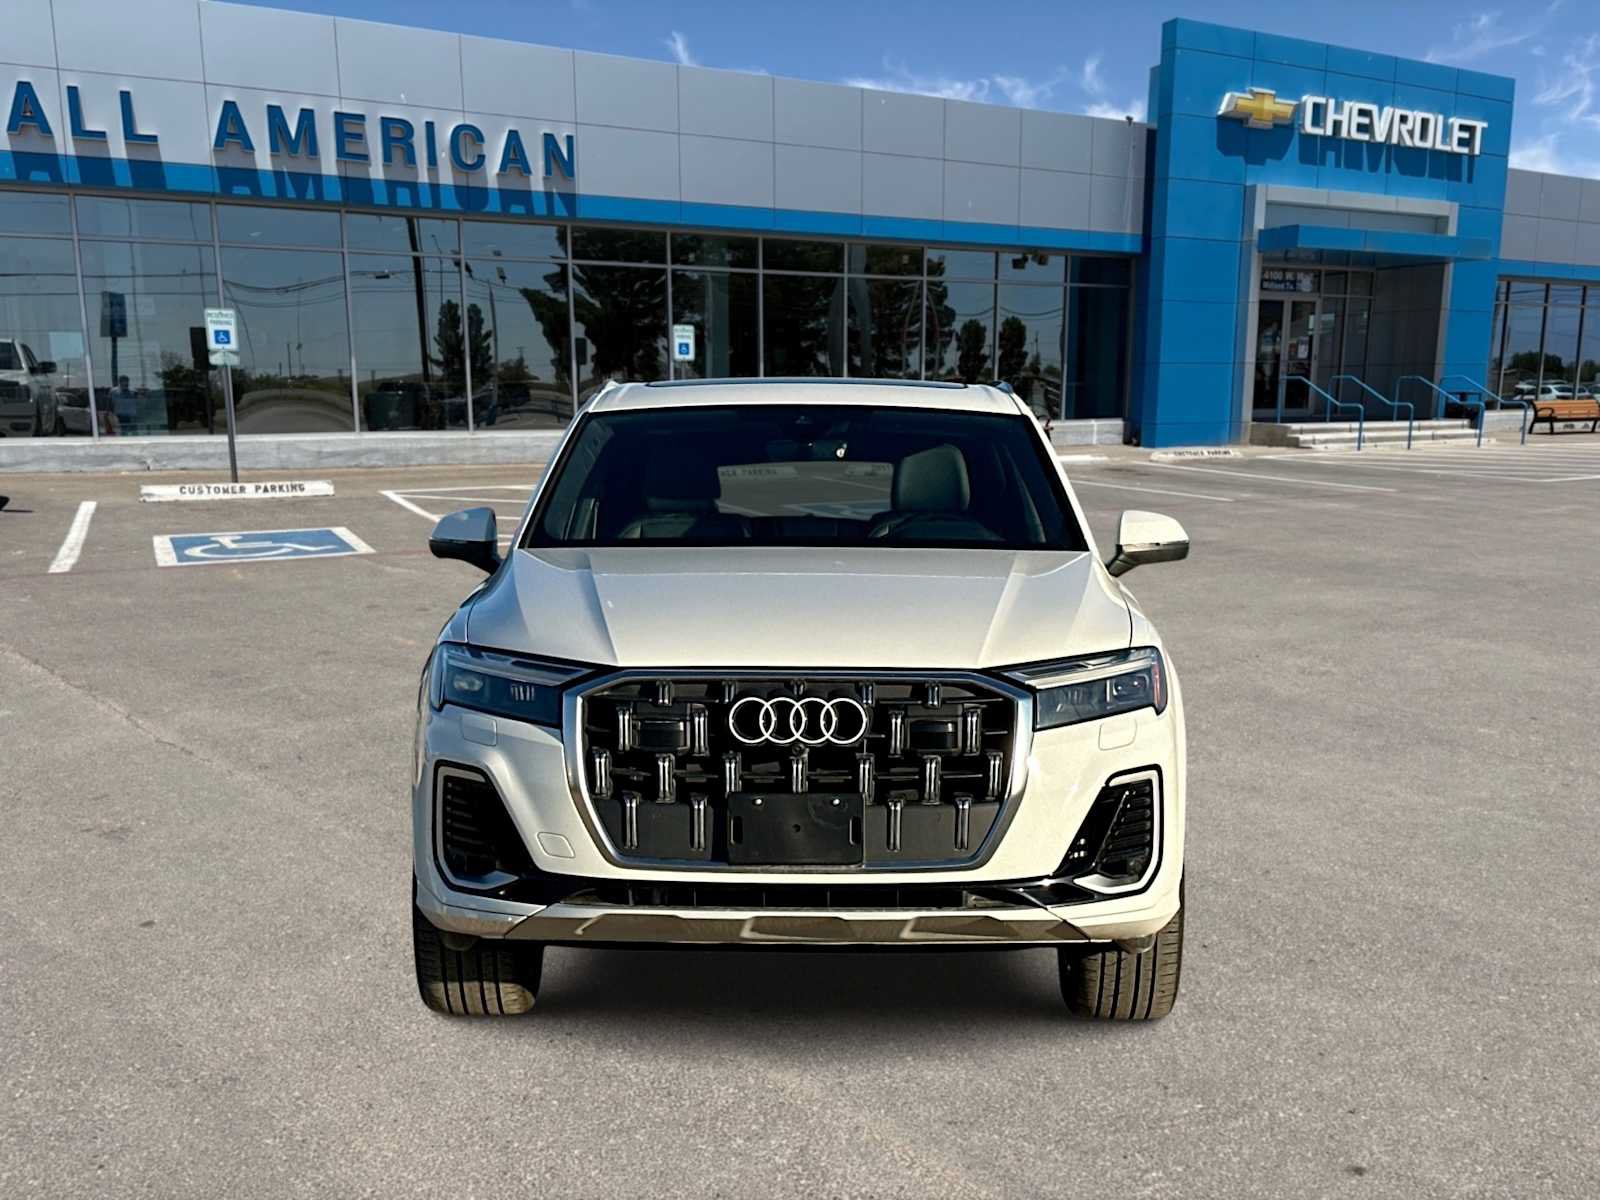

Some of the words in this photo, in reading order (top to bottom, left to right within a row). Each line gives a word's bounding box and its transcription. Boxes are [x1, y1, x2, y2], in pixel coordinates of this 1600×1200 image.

[7, 81, 158, 144] ALL
[213, 100, 575, 178] AMERICAN
[1302, 95, 1488, 155] CHEVROLET
[179, 484, 247, 495] CUSTOMER
[254, 483, 306, 494] PARKING
